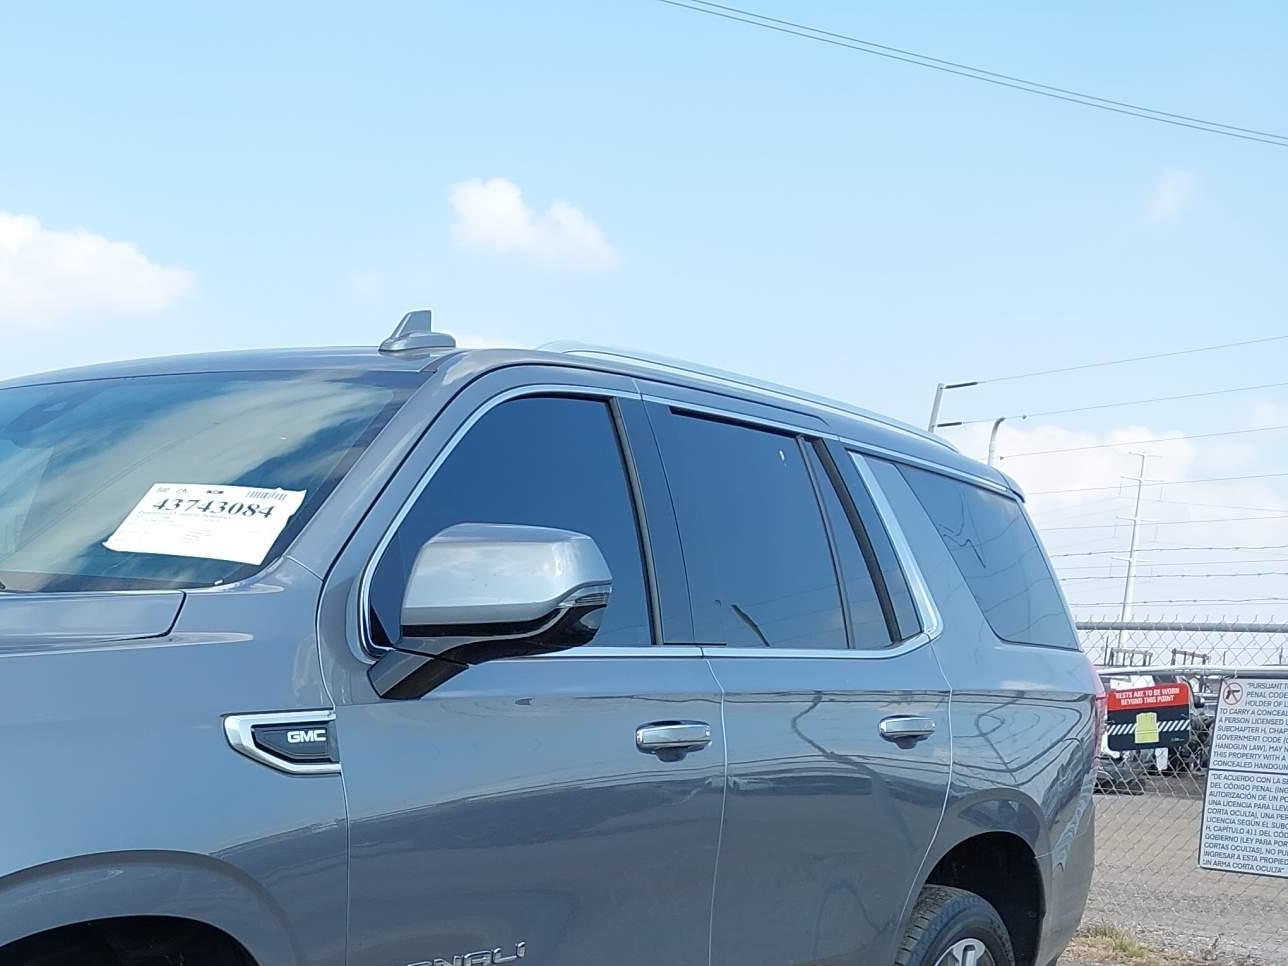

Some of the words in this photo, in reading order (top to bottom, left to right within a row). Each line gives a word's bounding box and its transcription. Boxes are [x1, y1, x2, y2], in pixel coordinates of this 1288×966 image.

[153, 499, 274, 518] 43743084
[1134, 690, 1144, 698] ARE
[1154, 688, 1161, 696] BE
[1144, 696, 1156, 704] THIS
[1157, 694, 1174, 702] POINT
[1217, 725, 1260, 734] SUBCHAPTER
[287, 730, 326, 743] GMC
[1215, 743, 1248, 751] HANDGUN
[1228, 752, 1262, 760] PROPERTY
[1213, 760, 1252, 768] CONCEALED
[1224, 774, 1255, 782] ACUERDO
[1256, 776, 1271, 784] CON
[1209, 791, 1256, 800] AUTORIZACIÓN
[1223, 800, 1253, 808] LICENCIA
[1207, 816, 1236, 824] LICENCIA
[1205, 833, 1238, 843] GOBIERNO
[1204, 842, 1229, 850] CORTAS
[1204, 850, 1235, 859] INGRESAR
[1213, 860, 1231, 868] ARMA
[1232, 862, 1254, 870] CORTA
